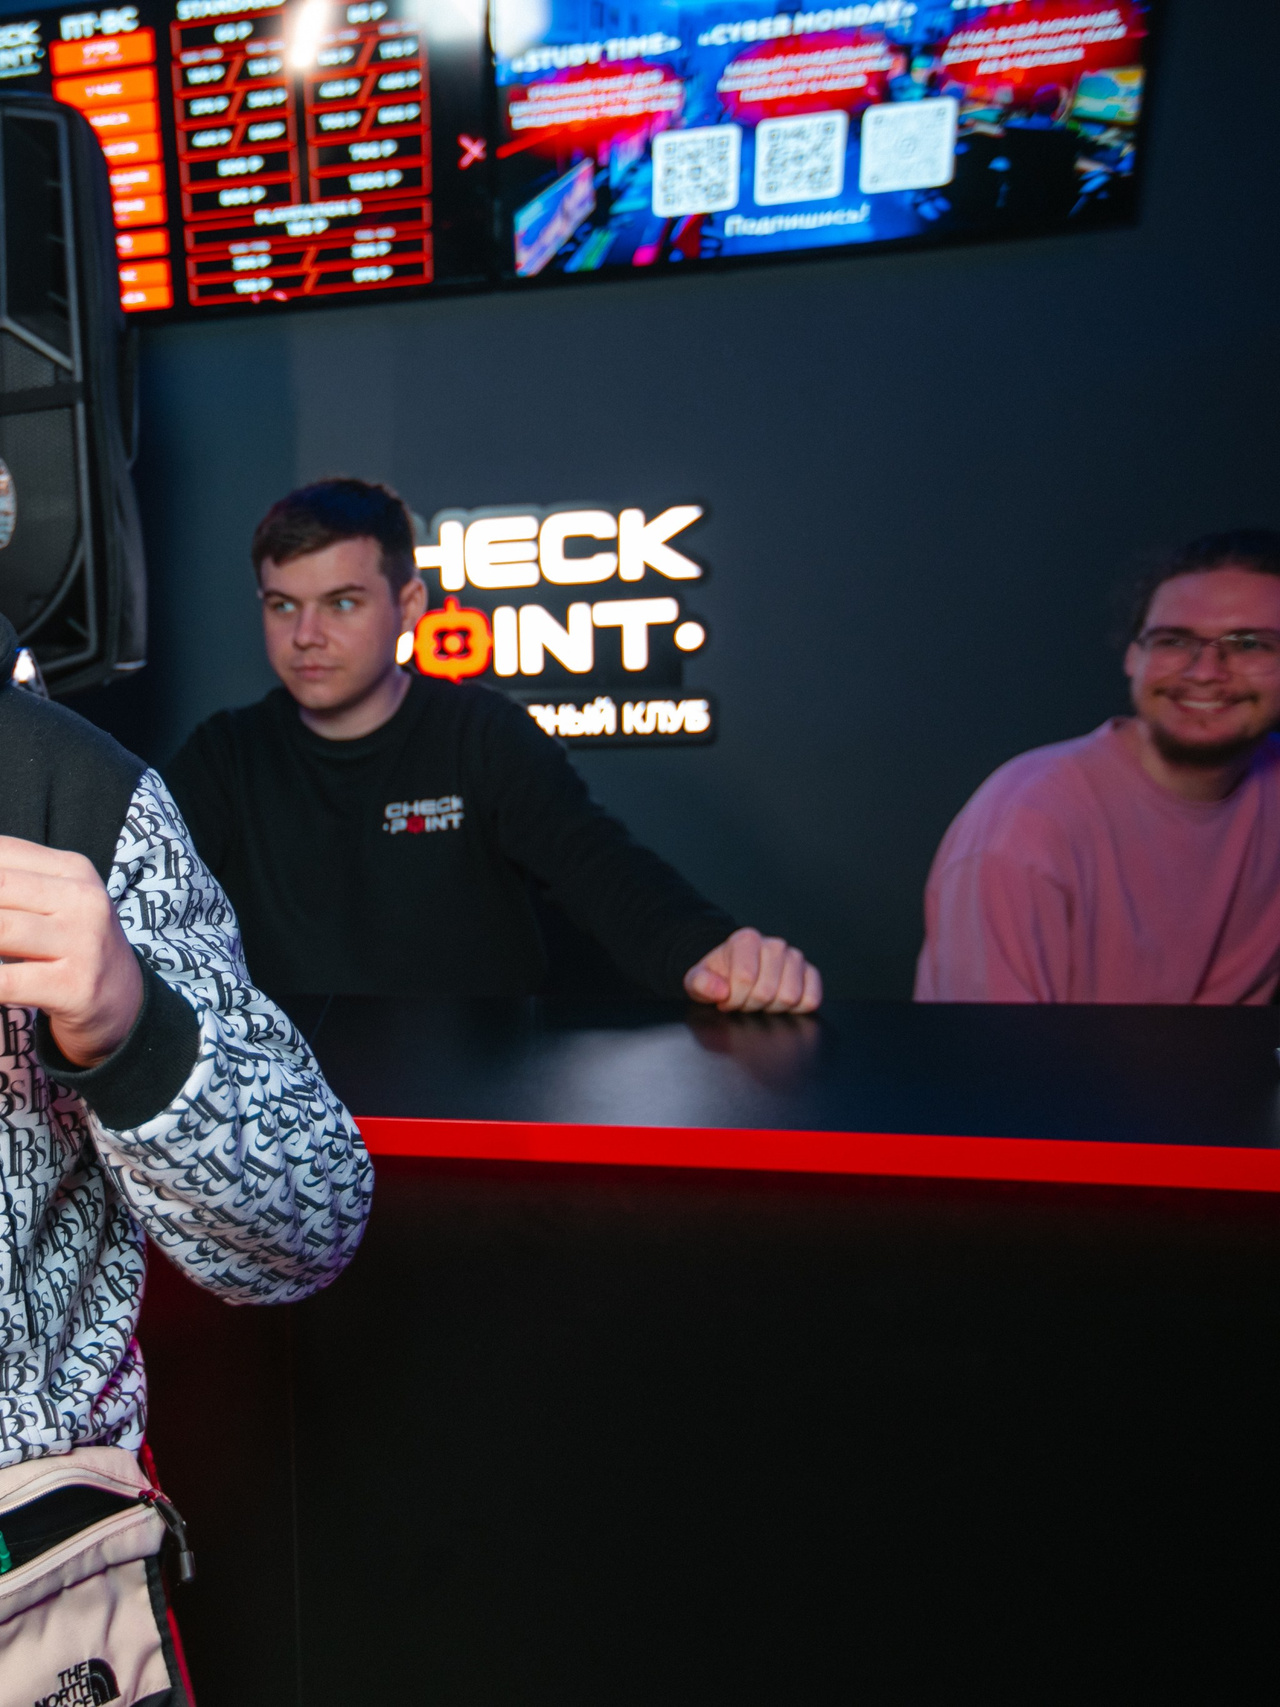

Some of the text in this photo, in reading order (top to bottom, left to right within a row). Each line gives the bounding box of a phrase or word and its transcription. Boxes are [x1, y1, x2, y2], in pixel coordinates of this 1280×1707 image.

[414, 505, 703, 591] HECK
[396, 597, 680, 683] OINT
[622, 699, 711, 735] КЛУБ
[385, 795, 463, 819] CHECK
[58, 1661, 89, 1688] THE
